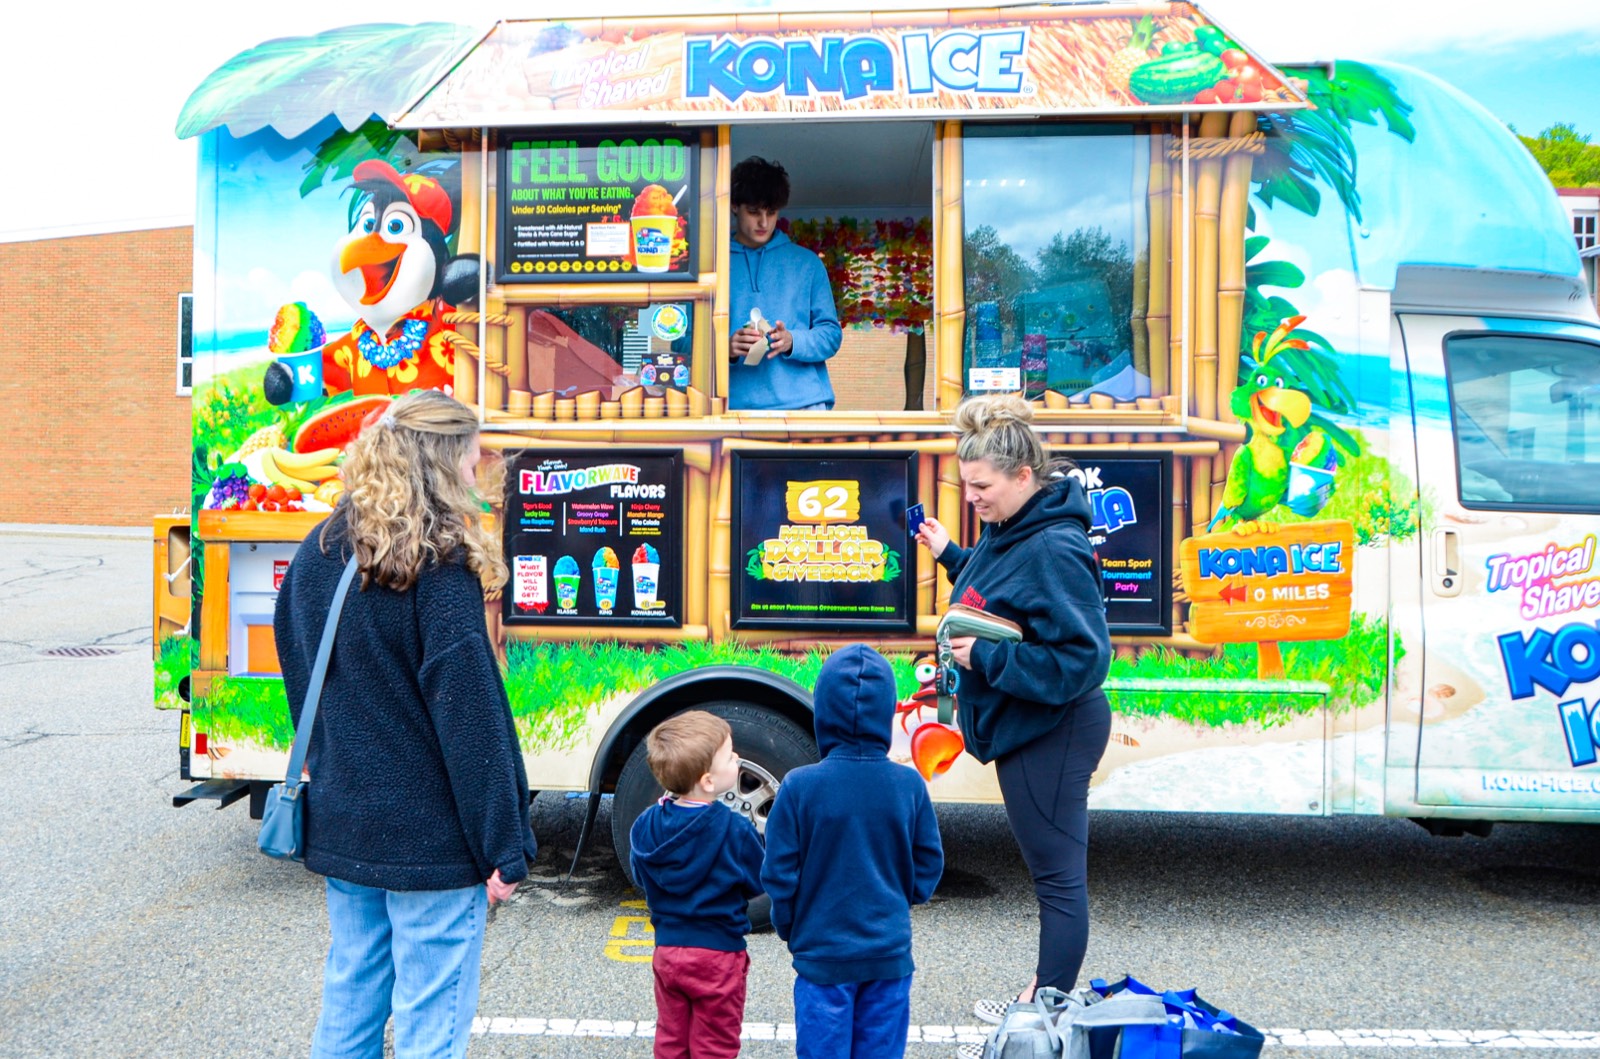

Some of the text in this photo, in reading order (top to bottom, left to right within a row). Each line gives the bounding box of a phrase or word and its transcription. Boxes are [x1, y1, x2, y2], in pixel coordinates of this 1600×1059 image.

[551, 43, 651, 88] Tropical
[685, 30, 1027, 102] KONA ICE
[579, 66, 672, 109] Shaved
[511, 138, 687, 184] FEEL GOOD
[511, 186, 635, 201] ABOUT WHAT YOU'RE EATING.
[512, 205, 535, 214] Under
[535, 205, 546, 214] 50
[547, 204, 576, 214] Calories
[577, 205, 590, 215] per
[297, 364, 316, 385] K
[520, 464, 638, 494] FLAVORWAVE
[610, 484, 666, 498] FLAVORS
[631, 503, 660, 511] Ninja Cherry
[797, 486, 849, 518] 62
[524, 510, 538, 518] Lucky
[531, 518, 555, 526] Raspberry
[598, 518, 618, 526] Treasure
[647, 511, 665, 519] Mango
[779, 525, 868, 541] MILLION
[763, 539, 884, 564] DOLLAR
[1198, 541, 1342, 580] KONA ICE
[1101, 558, 1152, 570] Team Sport
[1486, 534, 1596, 591] Tropical
[772, 563, 874, 583] GIVEBACK
[1102, 570, 1152, 580] Tournament
[1114, 582, 1138, 593] Party
[1254, 583, 1330, 602] 0 MILES
[1521, 577, 1600, 620] Shave
[1497, 620, 1600, 700] KO
[1481, 773, 1600, 794] KONA-ICE.C
